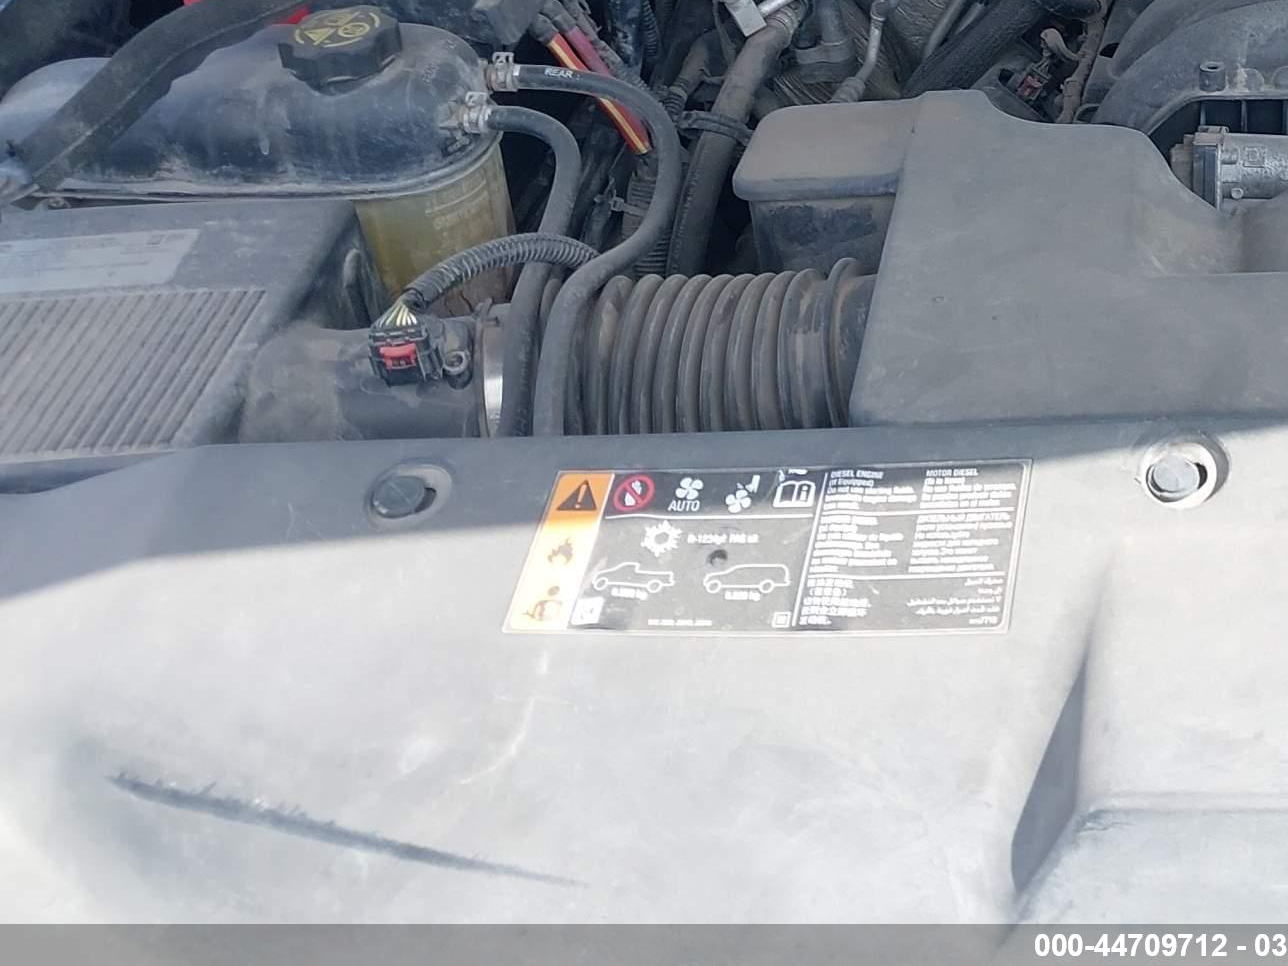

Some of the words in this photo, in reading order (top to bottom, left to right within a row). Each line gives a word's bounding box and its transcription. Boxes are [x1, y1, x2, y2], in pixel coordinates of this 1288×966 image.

[544, 67, 573, 78] REAR
[926, 469, 952, 477] MOTOR
[667, 499, 701, 512] AUTO
